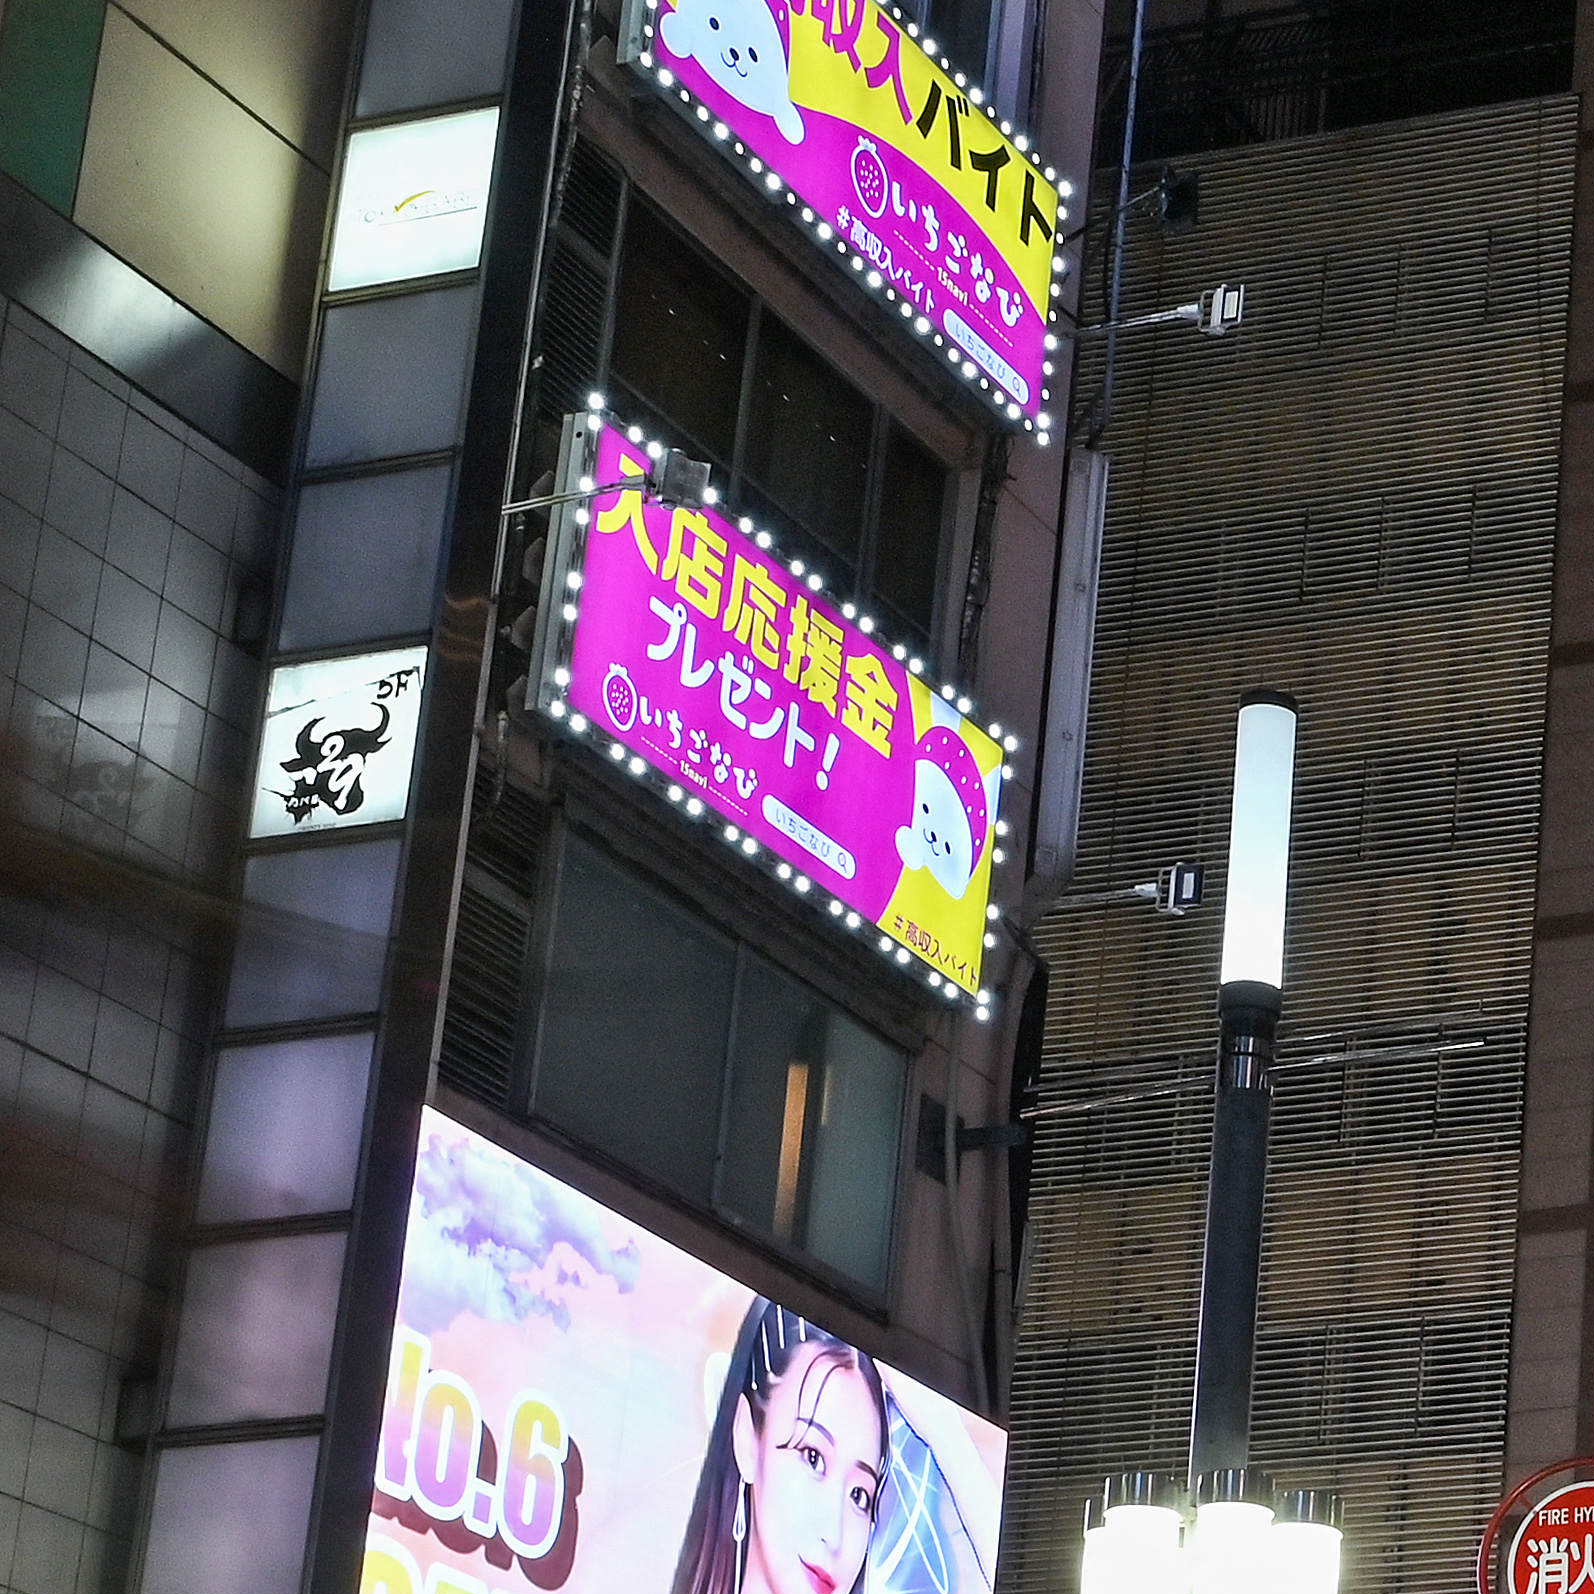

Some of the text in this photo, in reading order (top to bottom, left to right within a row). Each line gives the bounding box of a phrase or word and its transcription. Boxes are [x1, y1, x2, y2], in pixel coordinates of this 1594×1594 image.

[596, 452, 899, 760] 入店応援金
[1538, 1508, 1570, 1528] FIRE
